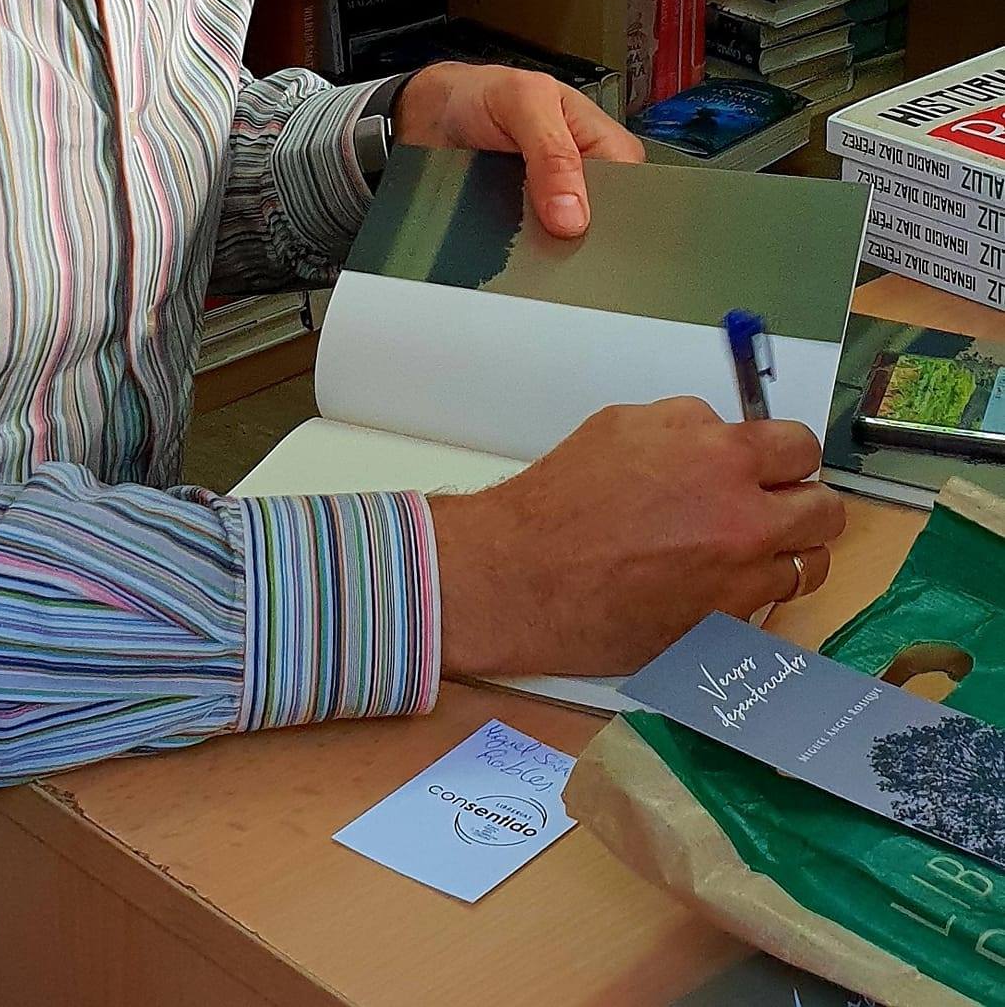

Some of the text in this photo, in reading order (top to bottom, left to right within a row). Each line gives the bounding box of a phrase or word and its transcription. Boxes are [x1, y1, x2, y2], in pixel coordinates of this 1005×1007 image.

[841, 130, 950, 180] IGNACIO DÍAZ PÉREZ
[894, 181, 919, 205] DÍAZ
[922, 190, 966, 219] IGNACIO
[896, 218, 969, 257] IGNACIO DÍAZ
[868, 238, 977, 293] IGNACIO DÍAZ PÉREZ
[698, 653, 758, 702] Versos
[712, 652, 808, 732] desenterrados
[798, 714, 854, 763] MIGUEL ÁNGEL
[427, 783, 538, 838] consentido
[890, 855, 994, 937] LIB
